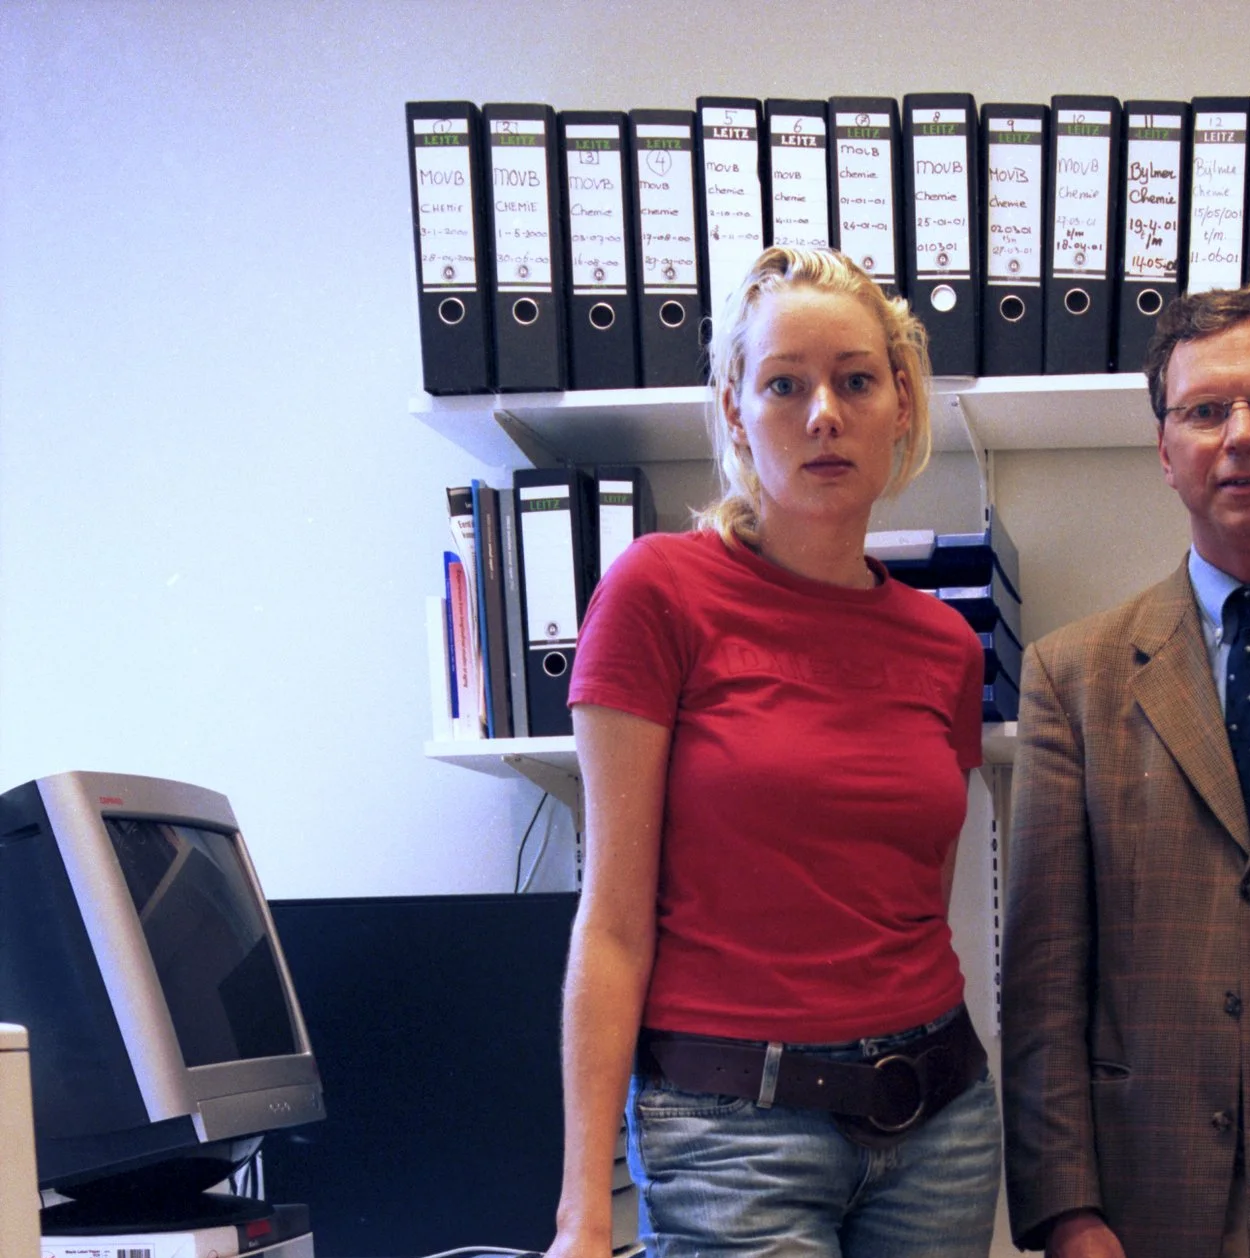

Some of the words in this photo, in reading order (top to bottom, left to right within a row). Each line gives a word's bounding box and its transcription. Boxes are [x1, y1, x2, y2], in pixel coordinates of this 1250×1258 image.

[723, 110, 738, 125] 5
[1145, 115, 1153, 129] 11
[1210, 117, 1222, 127] 12
[793, 118, 802, 133] 6
[923, 124, 958, 135] LEITZ
[1007, 120, 1015, 132] 9
[1068, 125, 1101, 135] LEITZ
[714, 128, 749, 139] LEITZ
[847, 128, 880, 138] LEITZ
[999, 134, 1032, 143] LEITZ
[1138, 130, 1168, 139] LEITZ
[1204, 132, 1235, 142] LEITZ
[424, 136, 459, 145] LEITZ
[501, 136, 535, 145] LEITZ
[576, 140, 610, 149] LEITZ
[647, 140, 681, 149] LEITZ
[781, 135, 817, 146] LEITZ
[1058, 158, 1099, 175] MOVB
[420, 169, 465, 186] MOVB
[494, 168, 540, 187] MOVB
[989, 168, 1029, 183] MOVB
[1129, 187, 1176, 205] Chemie
[529, 498, 561, 510] LEITZ
